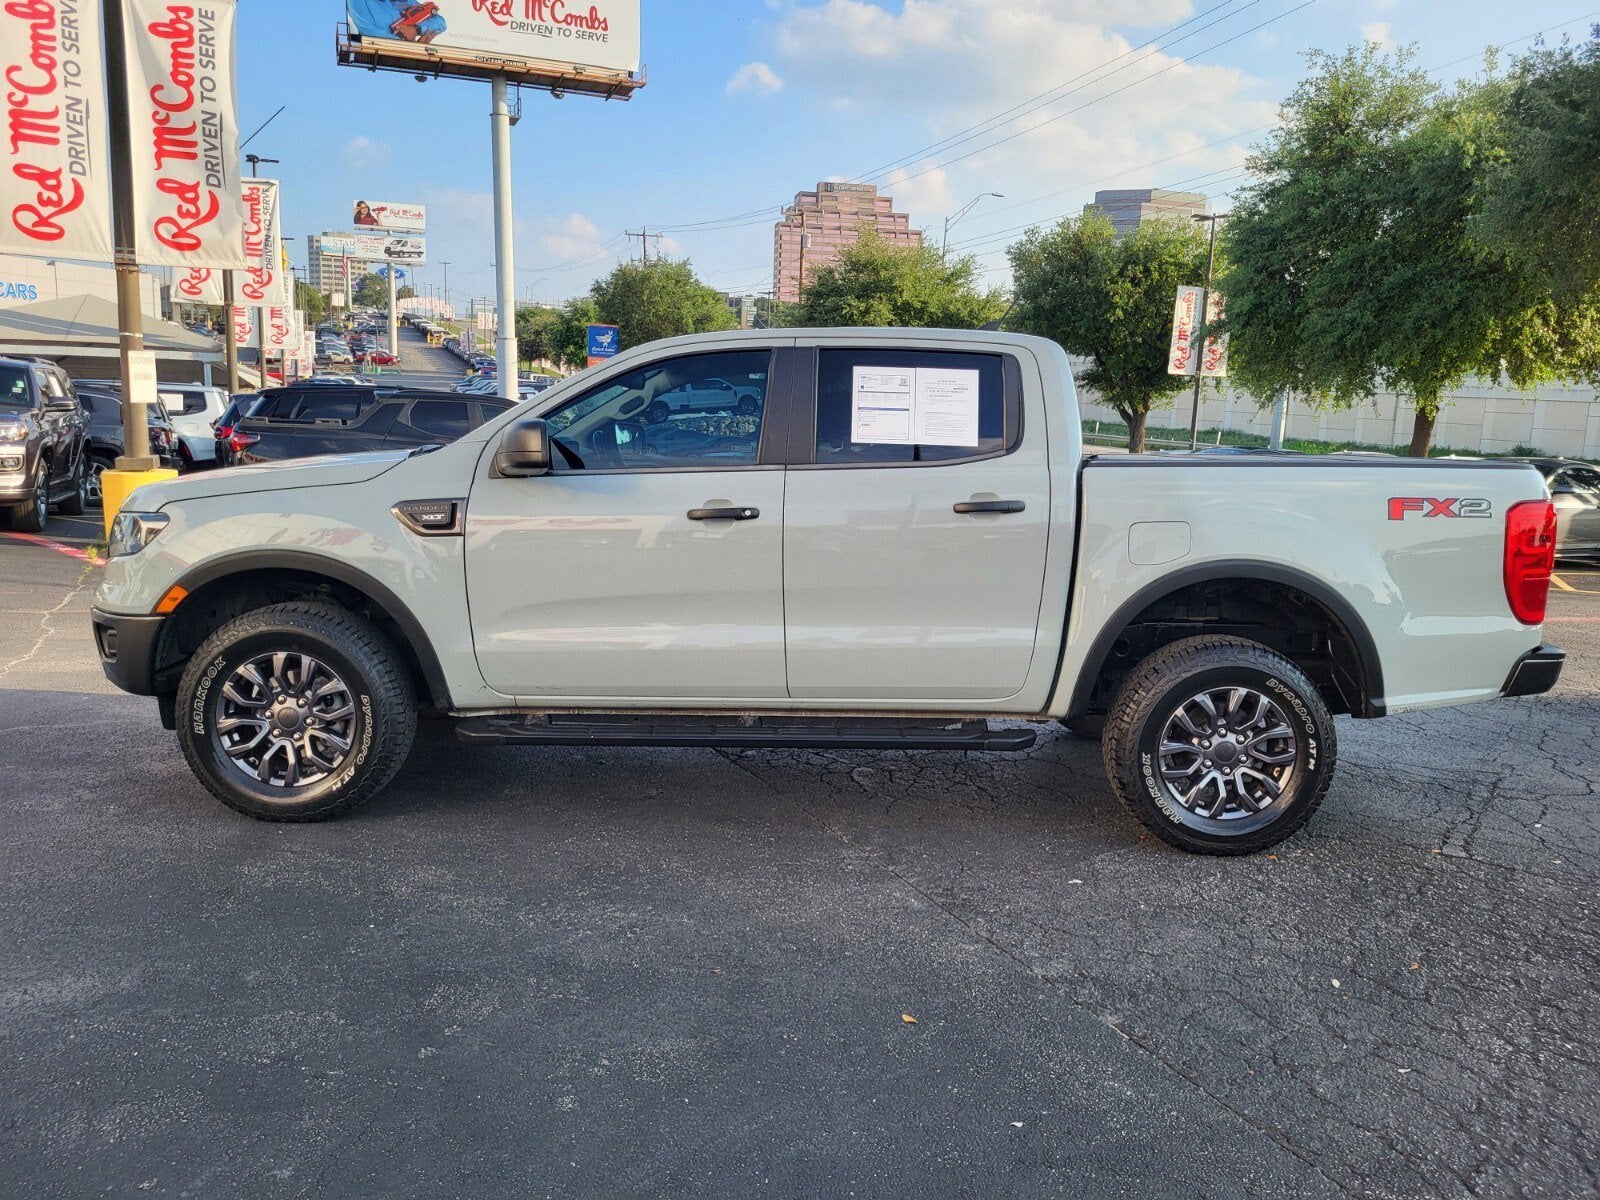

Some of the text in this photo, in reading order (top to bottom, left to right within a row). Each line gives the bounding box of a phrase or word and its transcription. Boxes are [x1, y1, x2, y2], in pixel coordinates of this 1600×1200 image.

[472, 0, 609, 32] Red McCombs
[510, 20, 609, 43] DRIVEN TO SERVE
[60, 0, 87, 177] DRIVEN TO SERV
[198, 7, 222, 189] DRIVEN TO SERVE
[4, 0, 84, 241] Red McComb
[148, 5, 220, 252] Red McCombs
[262, 187, 275, 270] DRIVEN TO SERVE
[241, 265, 272, 300] Red
[269, 323, 290, 345] Red
[1175, 291, 1194, 344] McCombs
[1174, 345, 1192, 370] Red
[1388, 497, 1492, 521] FX2
